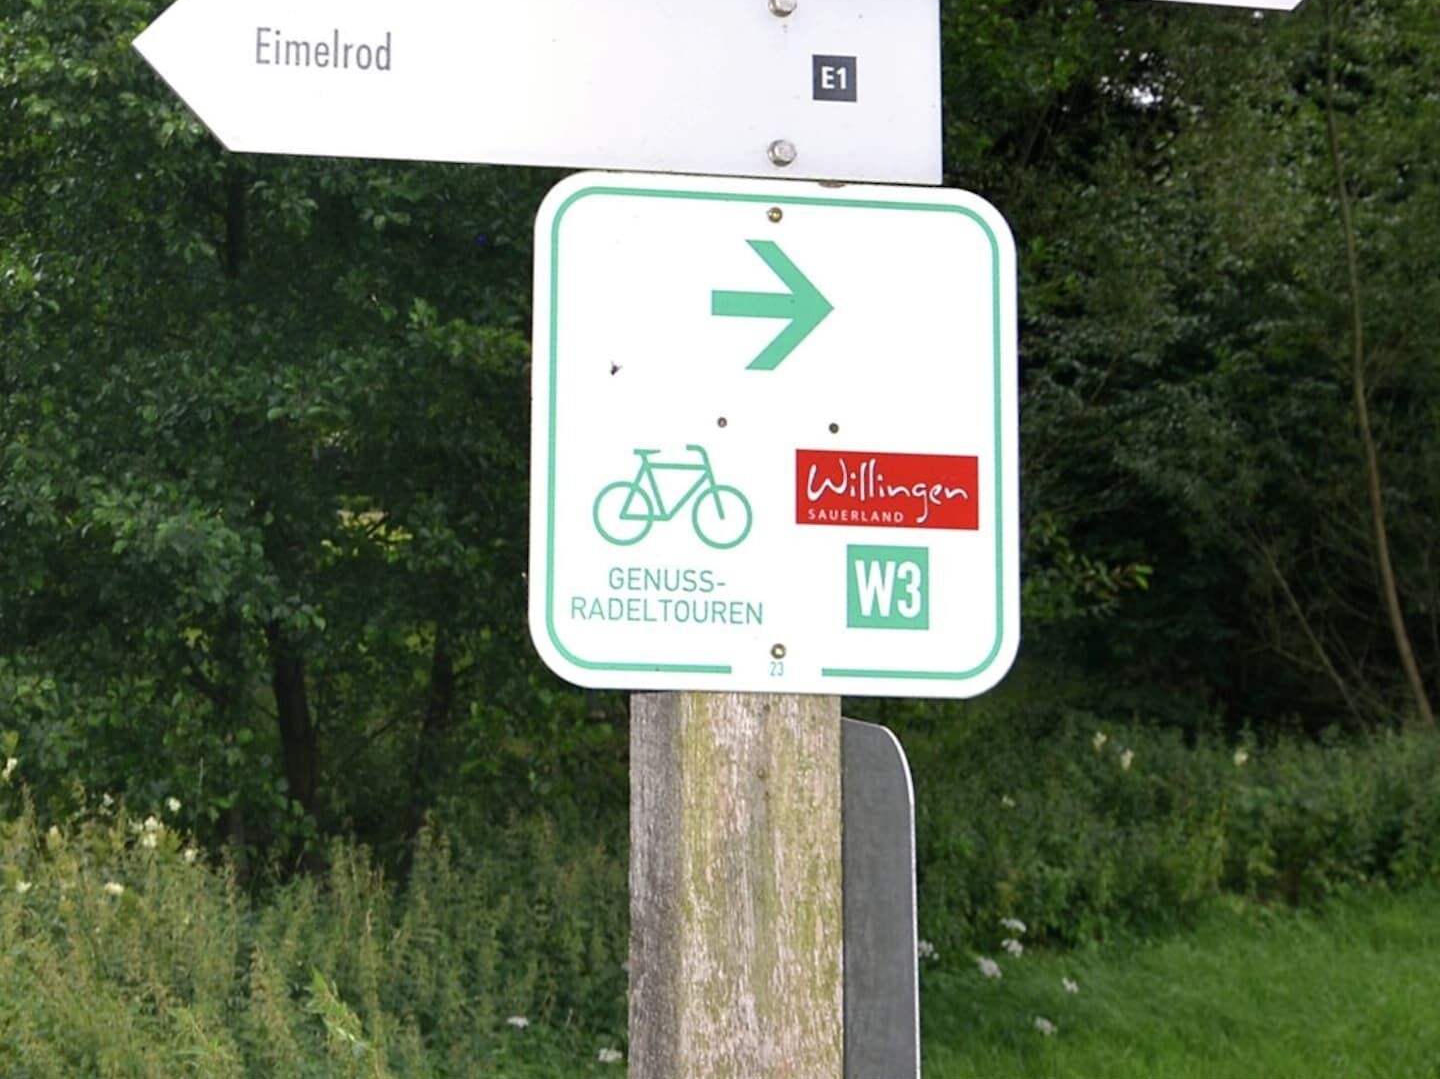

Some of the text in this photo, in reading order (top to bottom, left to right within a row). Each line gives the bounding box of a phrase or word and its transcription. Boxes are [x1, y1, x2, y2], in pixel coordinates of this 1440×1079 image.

[255, 26, 847, 90] Eimelrod E1
[807, 458, 969, 524] Willingen
[807, 508, 904, 523] SAUERLAND
[608, 566, 727, 593] GENUSS-
[854, 559, 922, 619] W3
[571, 596, 763, 626] RADELTOUREN
[770, 661, 785, 677] 23
